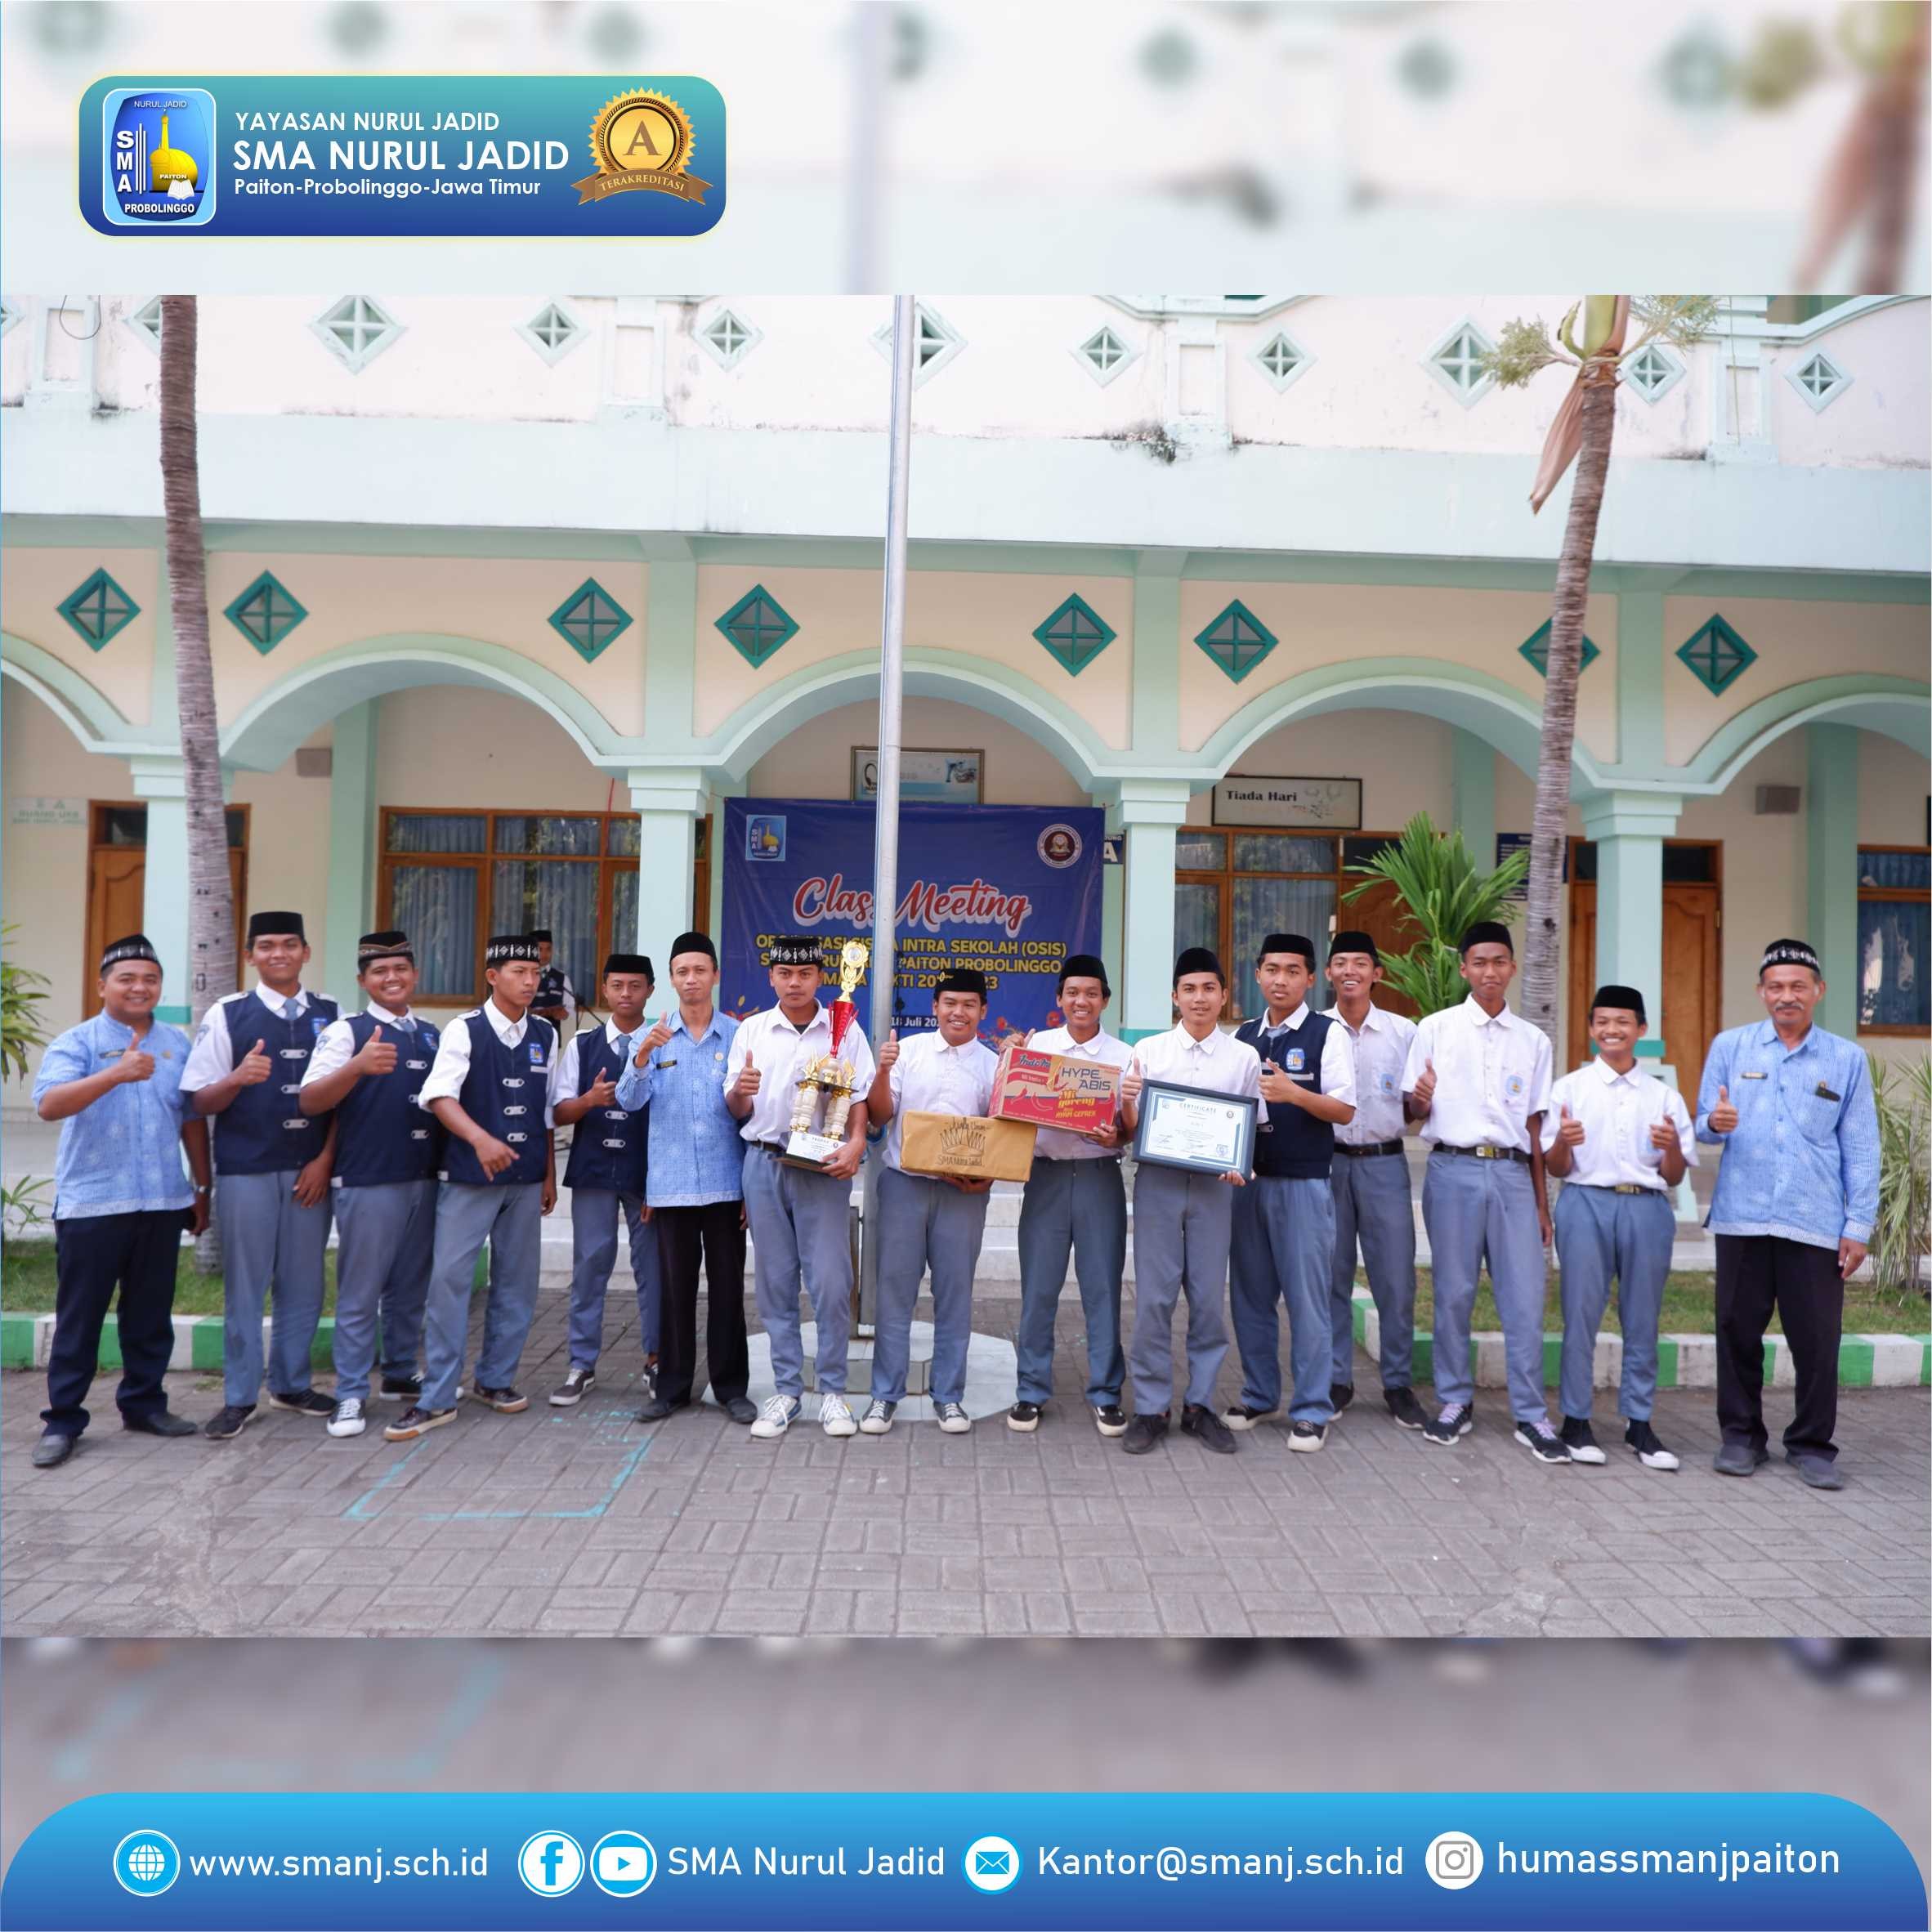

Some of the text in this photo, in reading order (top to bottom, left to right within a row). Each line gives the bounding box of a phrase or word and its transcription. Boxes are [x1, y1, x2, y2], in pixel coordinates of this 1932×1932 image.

[1227, 789, 1298, 803] Tiada Hari
[894, 879, 1032, 938] Meeting
[902, 938, 946, 952] INTRA
[950, 939, 1018, 955] SEKOLAH
[1022, 941, 1067, 958] (OSIS)
[955, 957, 1062, 973] PROBOLINGGO
[905, 1017, 923, 1026] Juli
[1062, 1067, 1102, 1079] HYPE
[1079, 1080, 1111, 1091] ABIS
